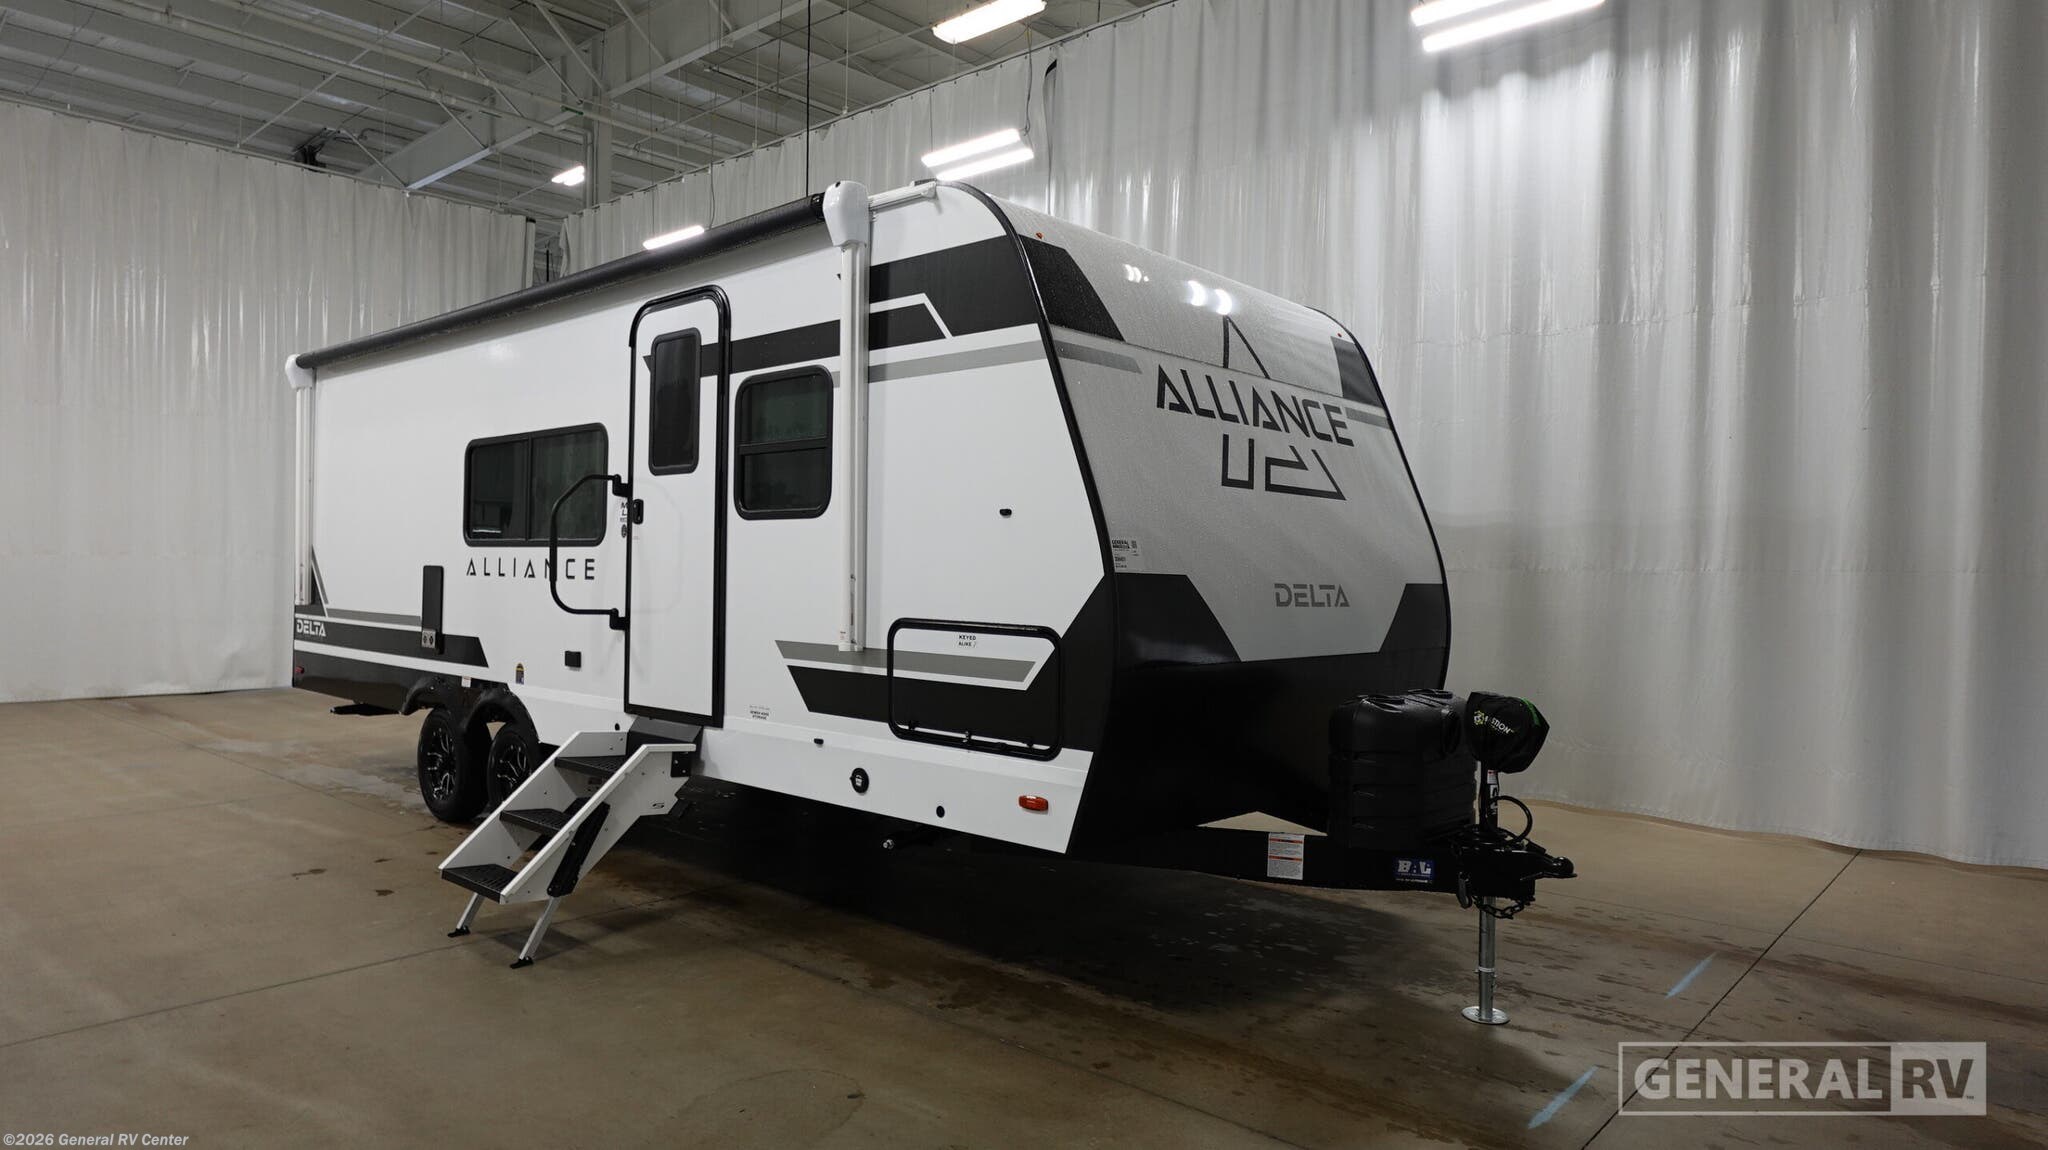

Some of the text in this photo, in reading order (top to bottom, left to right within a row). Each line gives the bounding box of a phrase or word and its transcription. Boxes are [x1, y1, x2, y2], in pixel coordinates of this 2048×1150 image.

[1156, 364, 1354, 447] ALLIANCE
[1274, 583, 1350, 608] DELTA
[296, 619, 326, 637] DELTA
